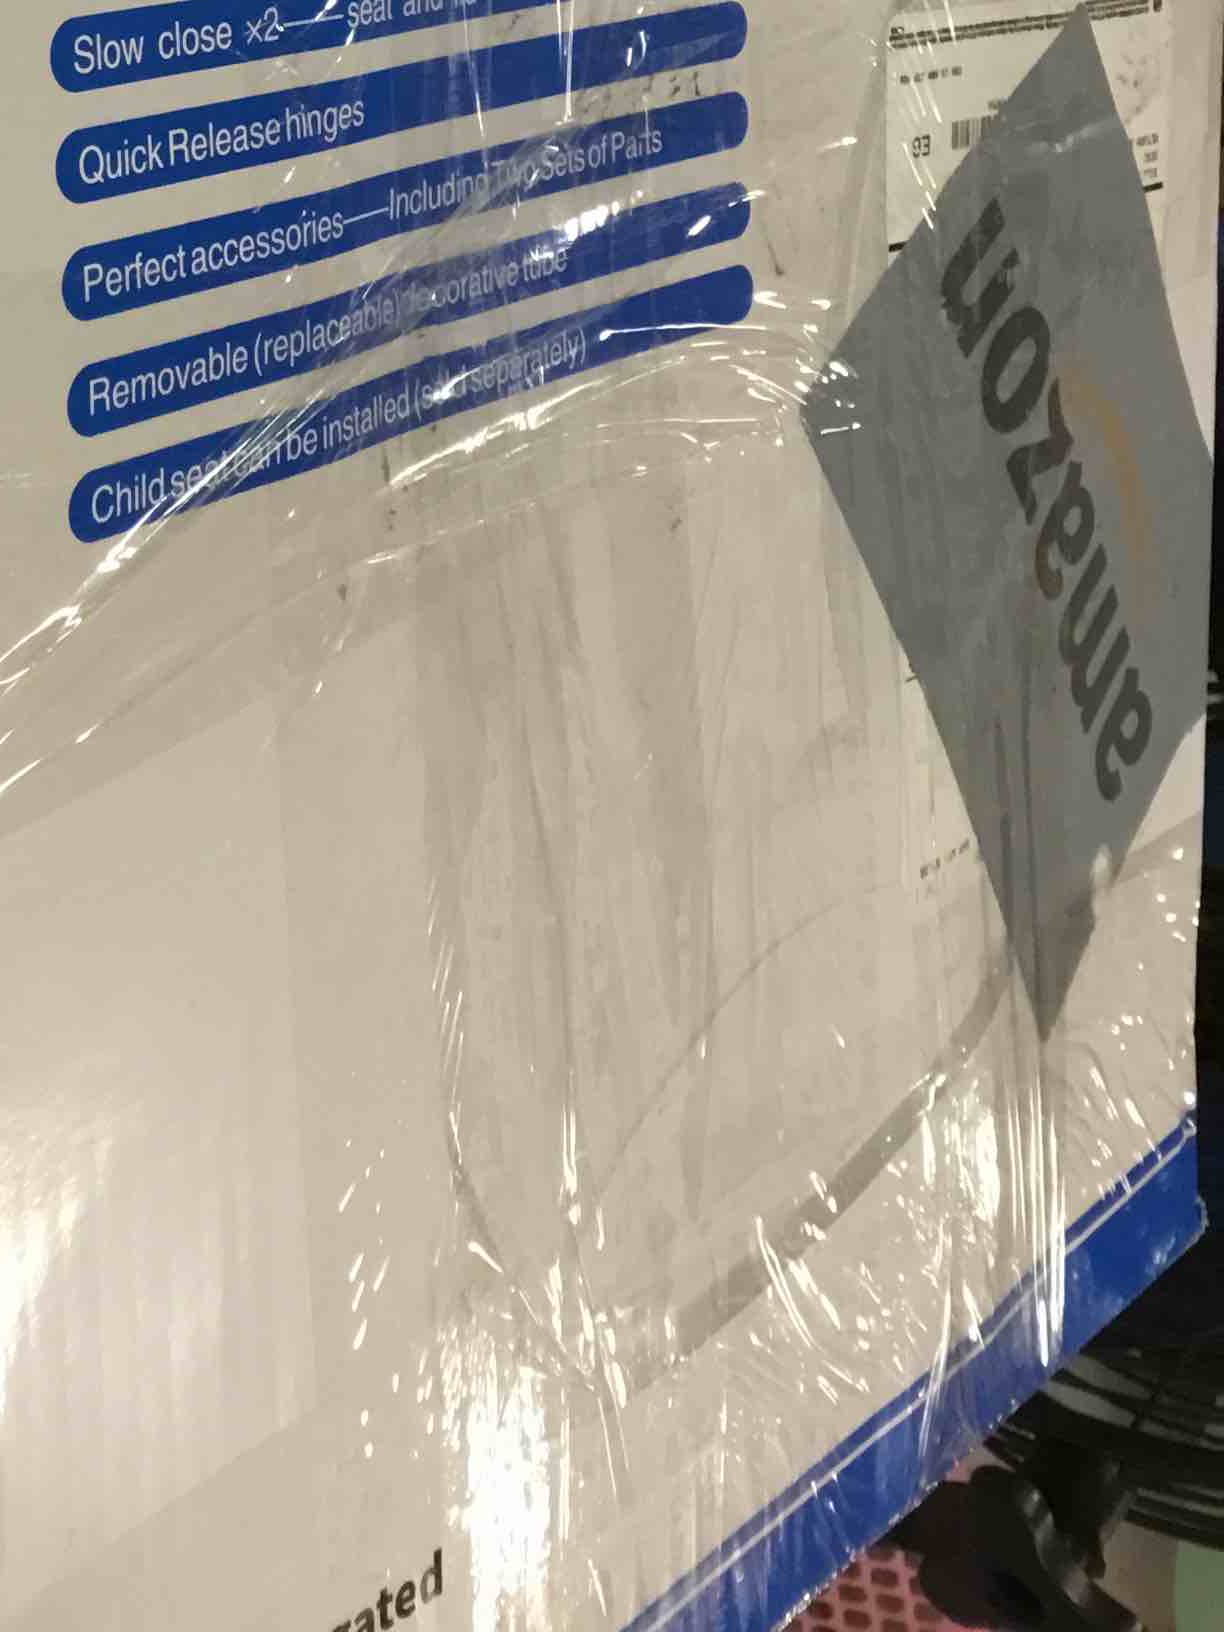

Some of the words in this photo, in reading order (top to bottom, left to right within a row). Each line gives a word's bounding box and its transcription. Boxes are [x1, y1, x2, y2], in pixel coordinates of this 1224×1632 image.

[73, 31, 144, 75] Slow
[156, 19, 233, 61] close
[78, 136, 164, 186] Quick
[169, 117, 282, 168] Release
[283, 99, 366, 153] hinges
[83, 247, 187, 303] Perfect
[588, 132, 609, 169] of
[610, 129, 664, 170] Parts
[88, 345, 249, 418] Removable
[91, 467, 165, 524] Child
[286, 426, 318, 462] be
[322, 381, 410, 448] installed
[941, 199, 1153, 802] amazon
